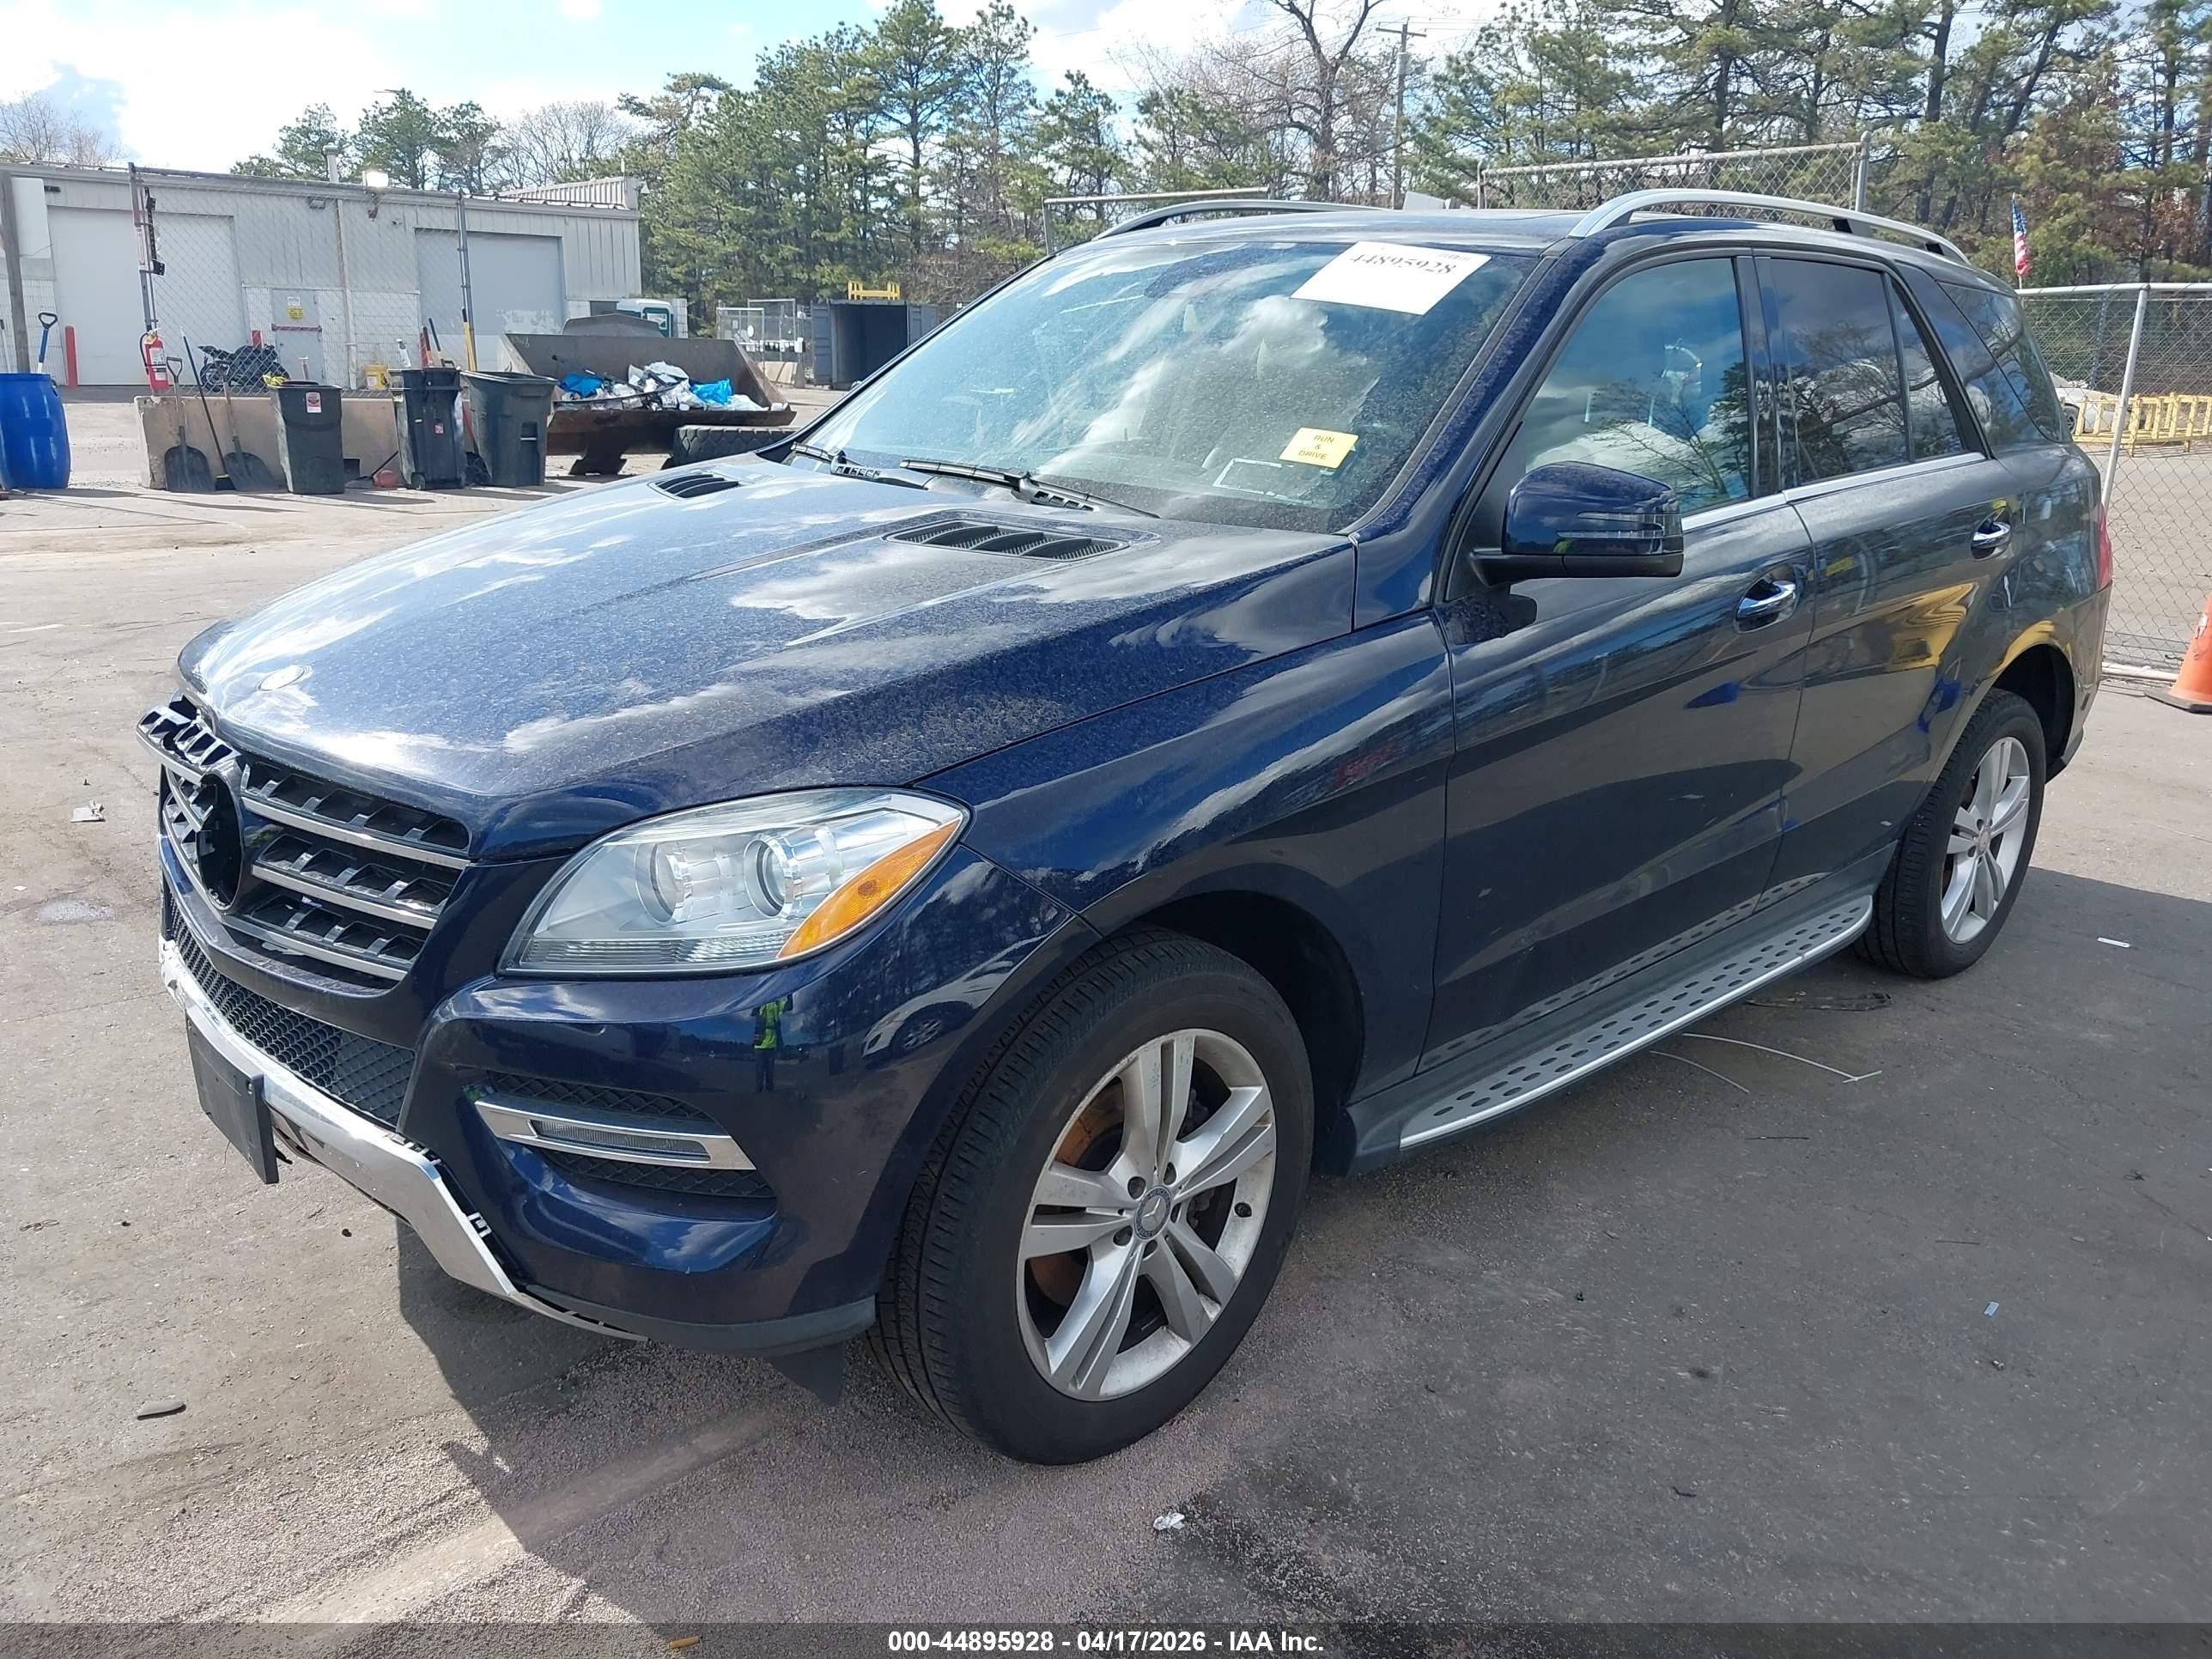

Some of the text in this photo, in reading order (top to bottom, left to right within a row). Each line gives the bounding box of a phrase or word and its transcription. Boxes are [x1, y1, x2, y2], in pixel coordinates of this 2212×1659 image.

[1350, 254, 1456, 274] 44895928
[1314, 434, 1334, 443] RUN
[1298, 450, 1328, 460] DRIVE
